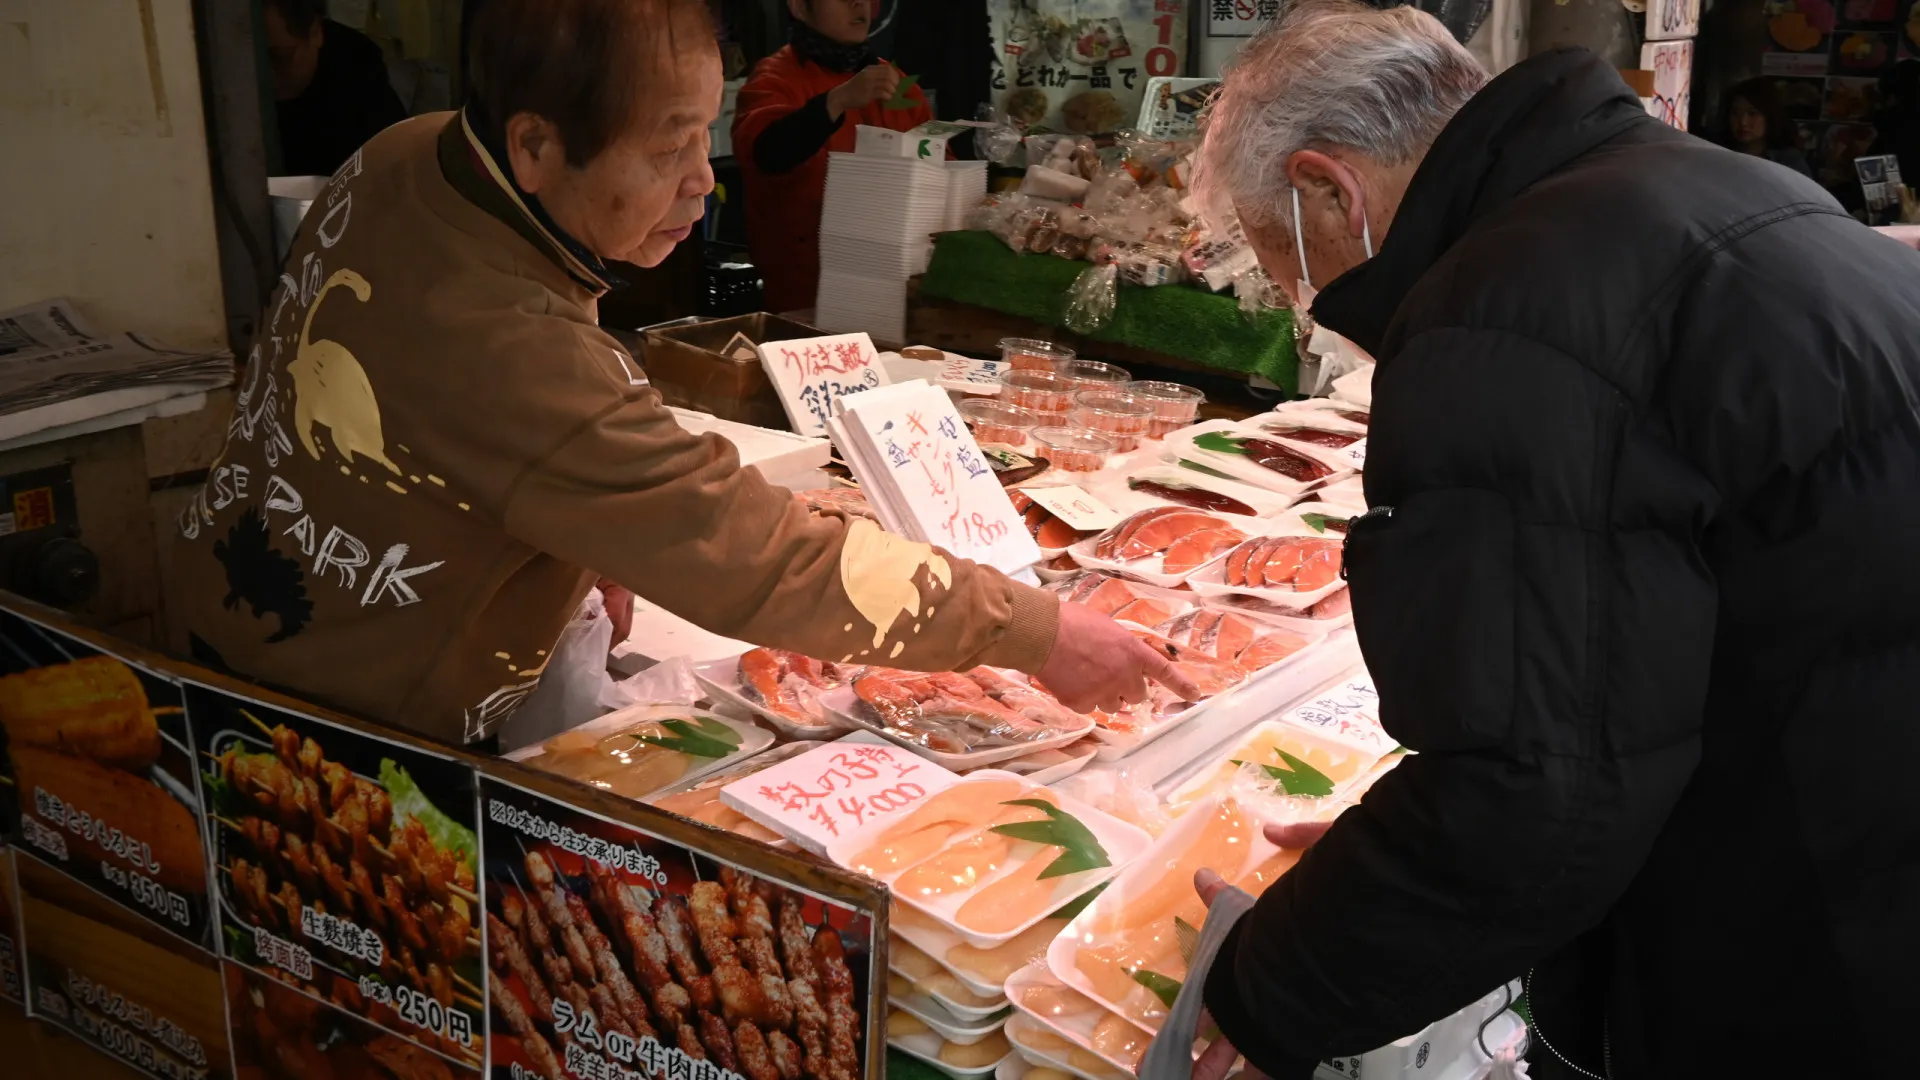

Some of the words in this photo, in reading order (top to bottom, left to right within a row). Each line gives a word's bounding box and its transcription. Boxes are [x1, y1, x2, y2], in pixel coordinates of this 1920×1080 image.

[262, 474, 446, 608] PARK
[488, 798, 668, 887] ※2本から注文承ります。
[551, 996, 602, 1051] ラム
[605, 1030, 635, 1063] or
